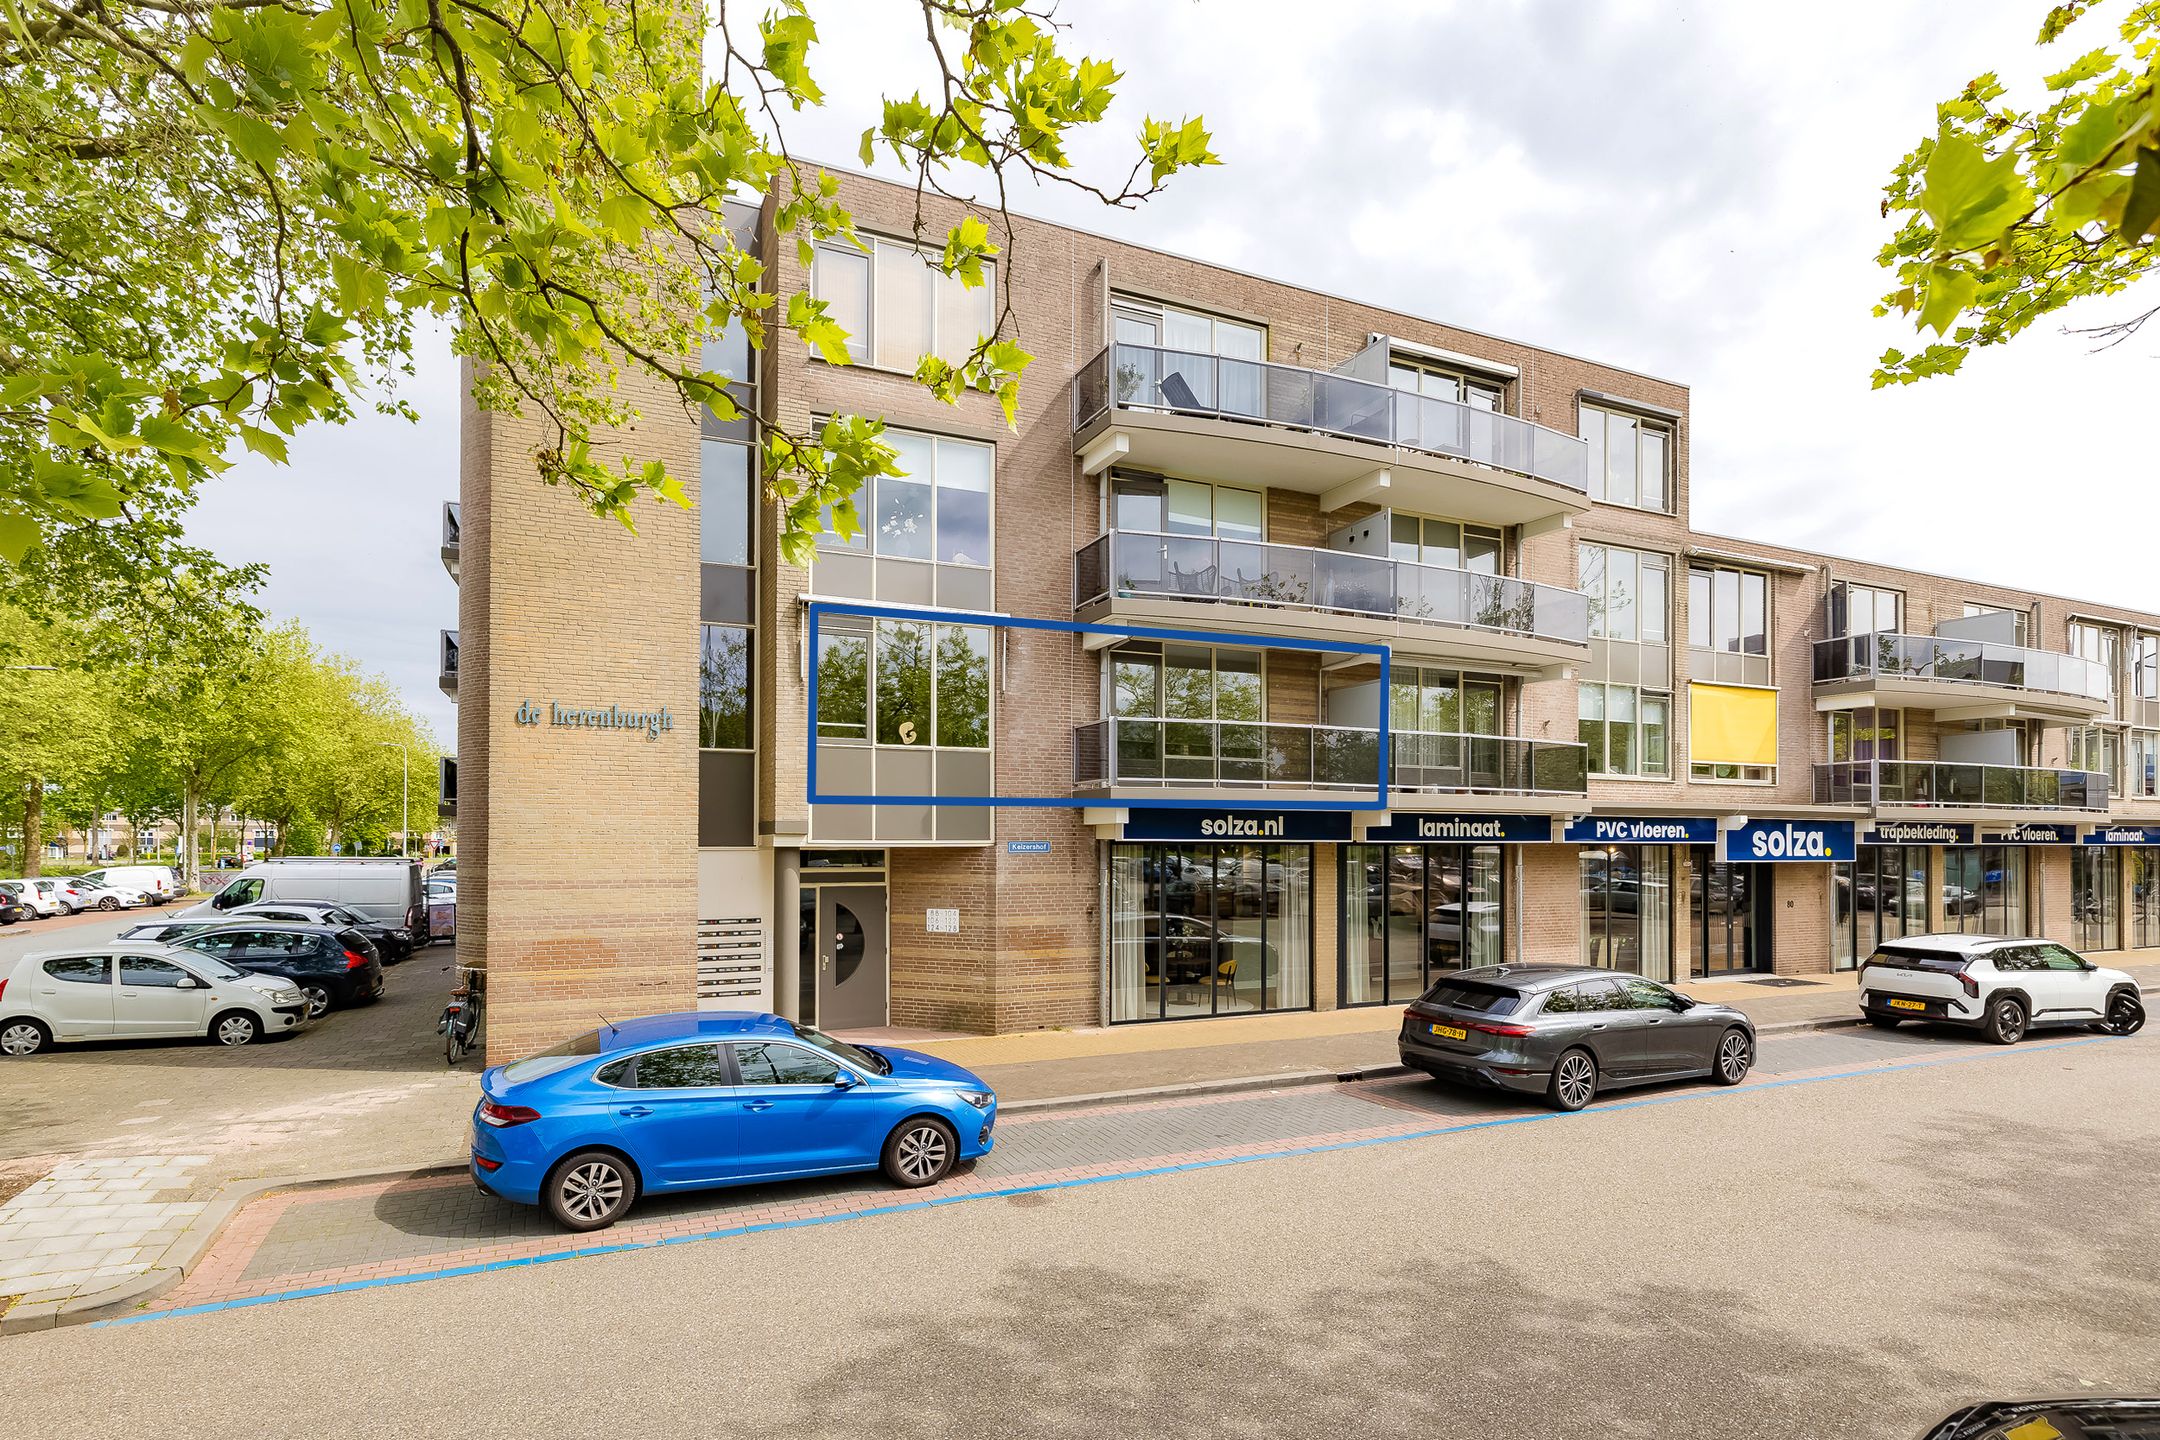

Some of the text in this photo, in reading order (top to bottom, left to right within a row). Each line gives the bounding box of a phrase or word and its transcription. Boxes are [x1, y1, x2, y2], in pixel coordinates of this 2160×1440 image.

[517, 699, 673, 739] de herenburgh
[1201, 815, 1284, 836] solza.nl
[1418, 817, 1505, 837] laminaat.
[1596, 821, 1689, 839] PVC vloeren.
[1880, 824, 1959, 844] trapbekleding.
[2021, 827, 2059, 841] vloeren.
[2105, 828, 2145, 842] laminaat.
[1752, 823, 1832, 857] solza.
[1786, 900, 1794, 908] 80
[1433, 1025, 1464, 1038] JHG-78-H
